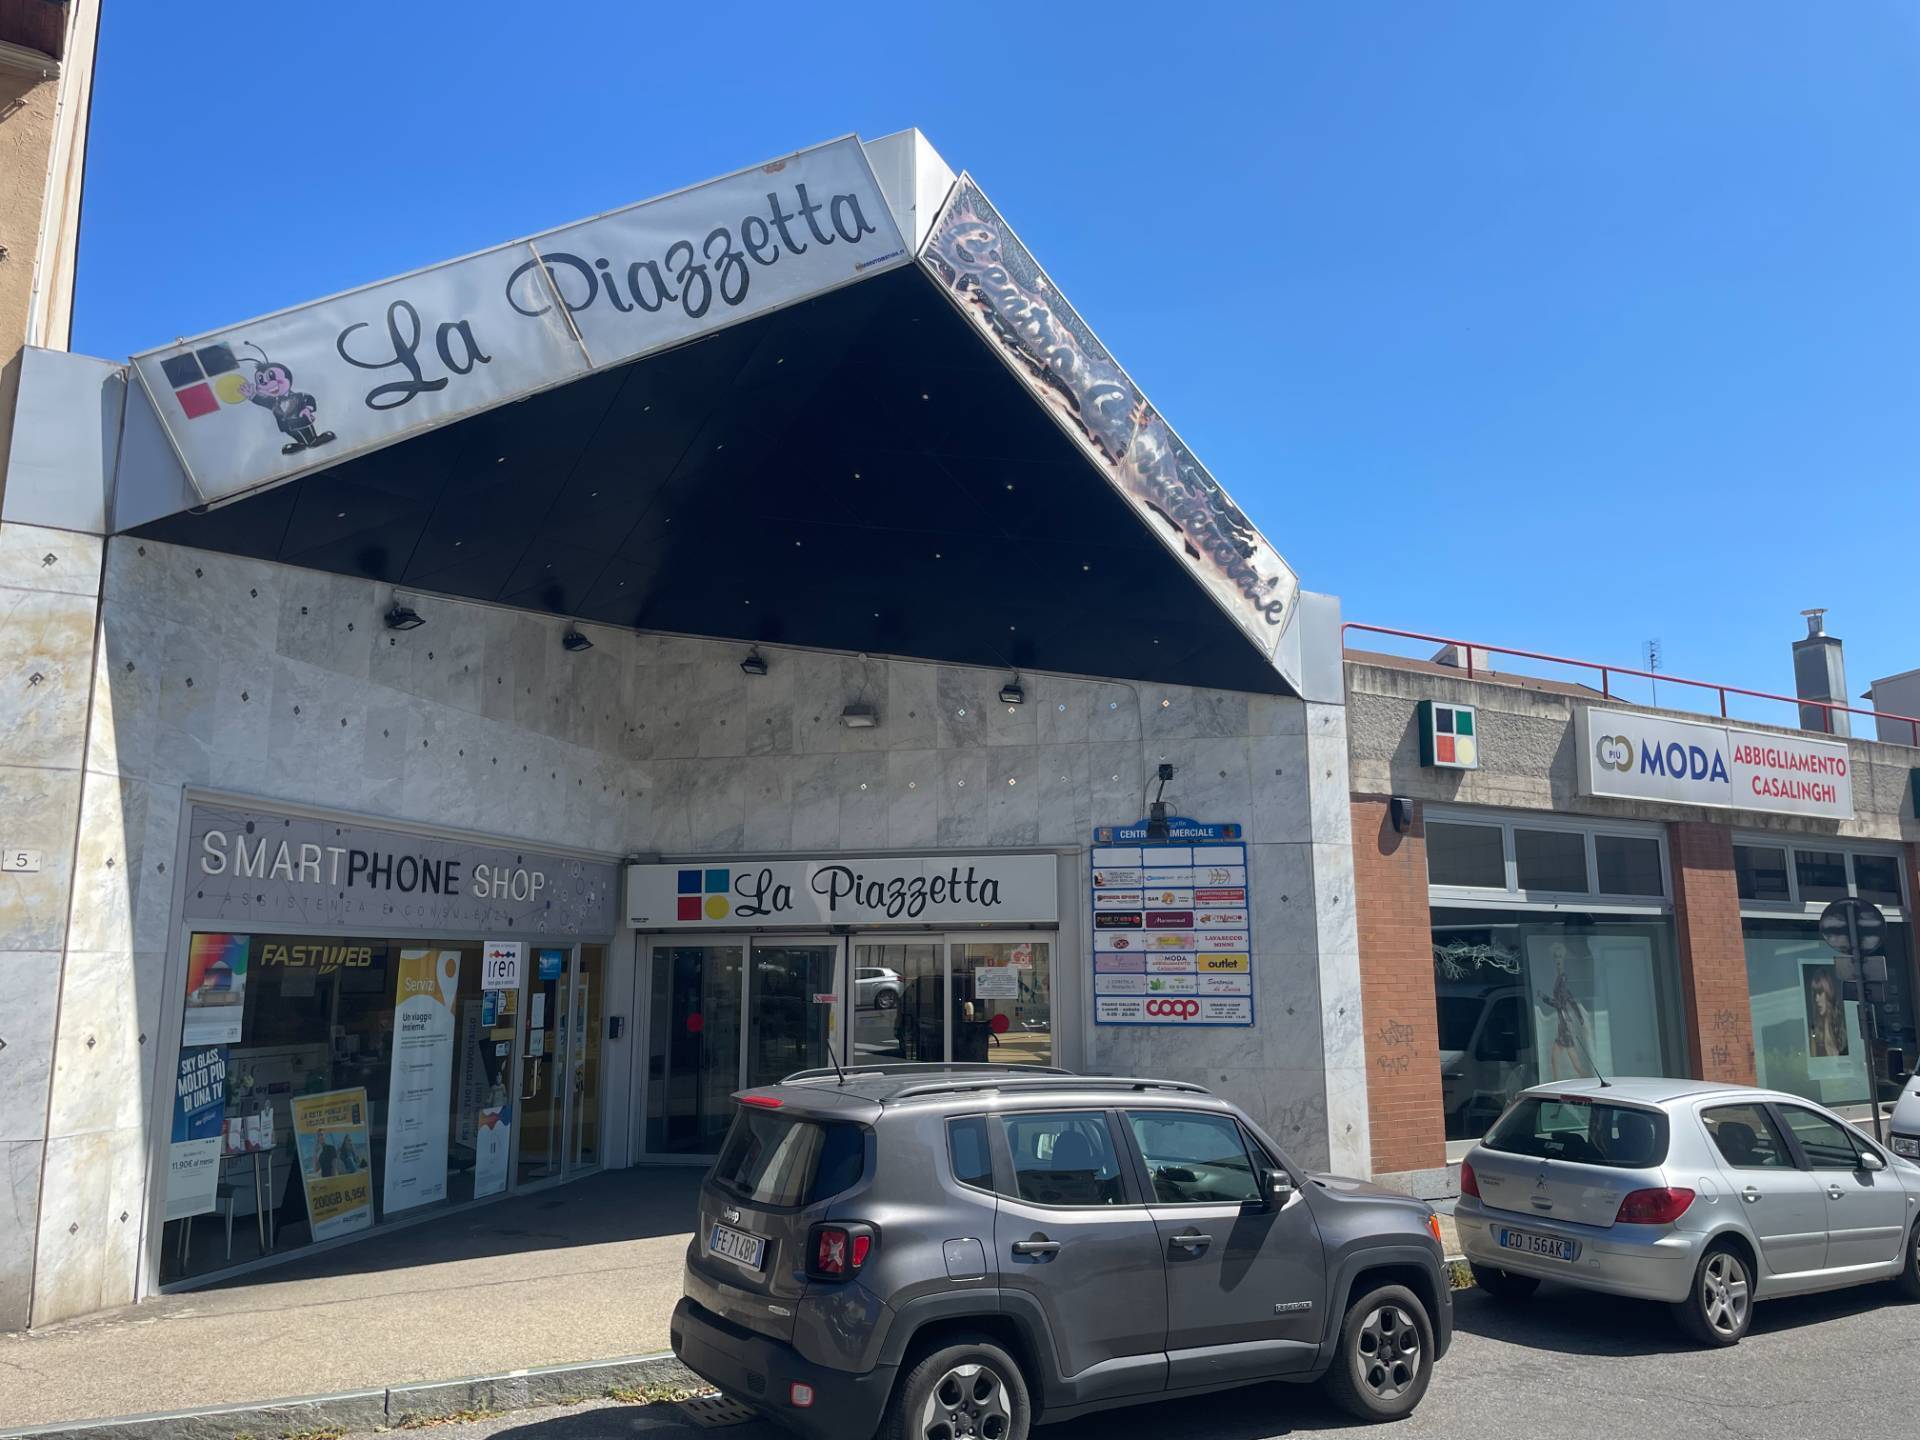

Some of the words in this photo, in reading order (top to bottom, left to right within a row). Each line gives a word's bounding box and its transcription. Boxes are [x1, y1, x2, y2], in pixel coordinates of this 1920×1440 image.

[336, 299, 492, 411] La
[506, 182, 876, 342] Piazzetta
[1640, 737, 1730, 784] MODA
[1733, 743, 1847, 778] ABBIGLIAMENTO
[1751, 775, 1837, 804] CASALINGHI
[1120, 829, 1147, 839] CENTR
[15, 853, 28, 867] 5
[200, 830, 461, 896] SMARTPHONE
[472, 863, 545, 902] SHOP
[223, 891, 366, 913] ASSISTENZA
[734, 867, 793, 918] La
[811, 865, 1002, 919] Piazzetta
[261, 944, 372, 975] FASTWEB
[487, 960, 515, 978] iren
[1207, 957, 1238, 969] outlet
[405, 977, 435, 992] Servizi
[1146, 999, 1200, 1021] coop
[178, 1068, 208, 1097] MOLTO
[210, 1058, 226, 1083] PIÙ
[181, 1059, 196, 1075] SKY
[183, 1094, 193, 1112] DI
[193, 1087, 211, 1108] UNA
[212, 1081, 223, 1100] TV
[723, 1205, 740, 1224] Jeep
[717, 1229, 729, 1251] FE
[1508, 1232, 1523, 1248] CD
[1527, 1236, 1562, 1257] 156AK
